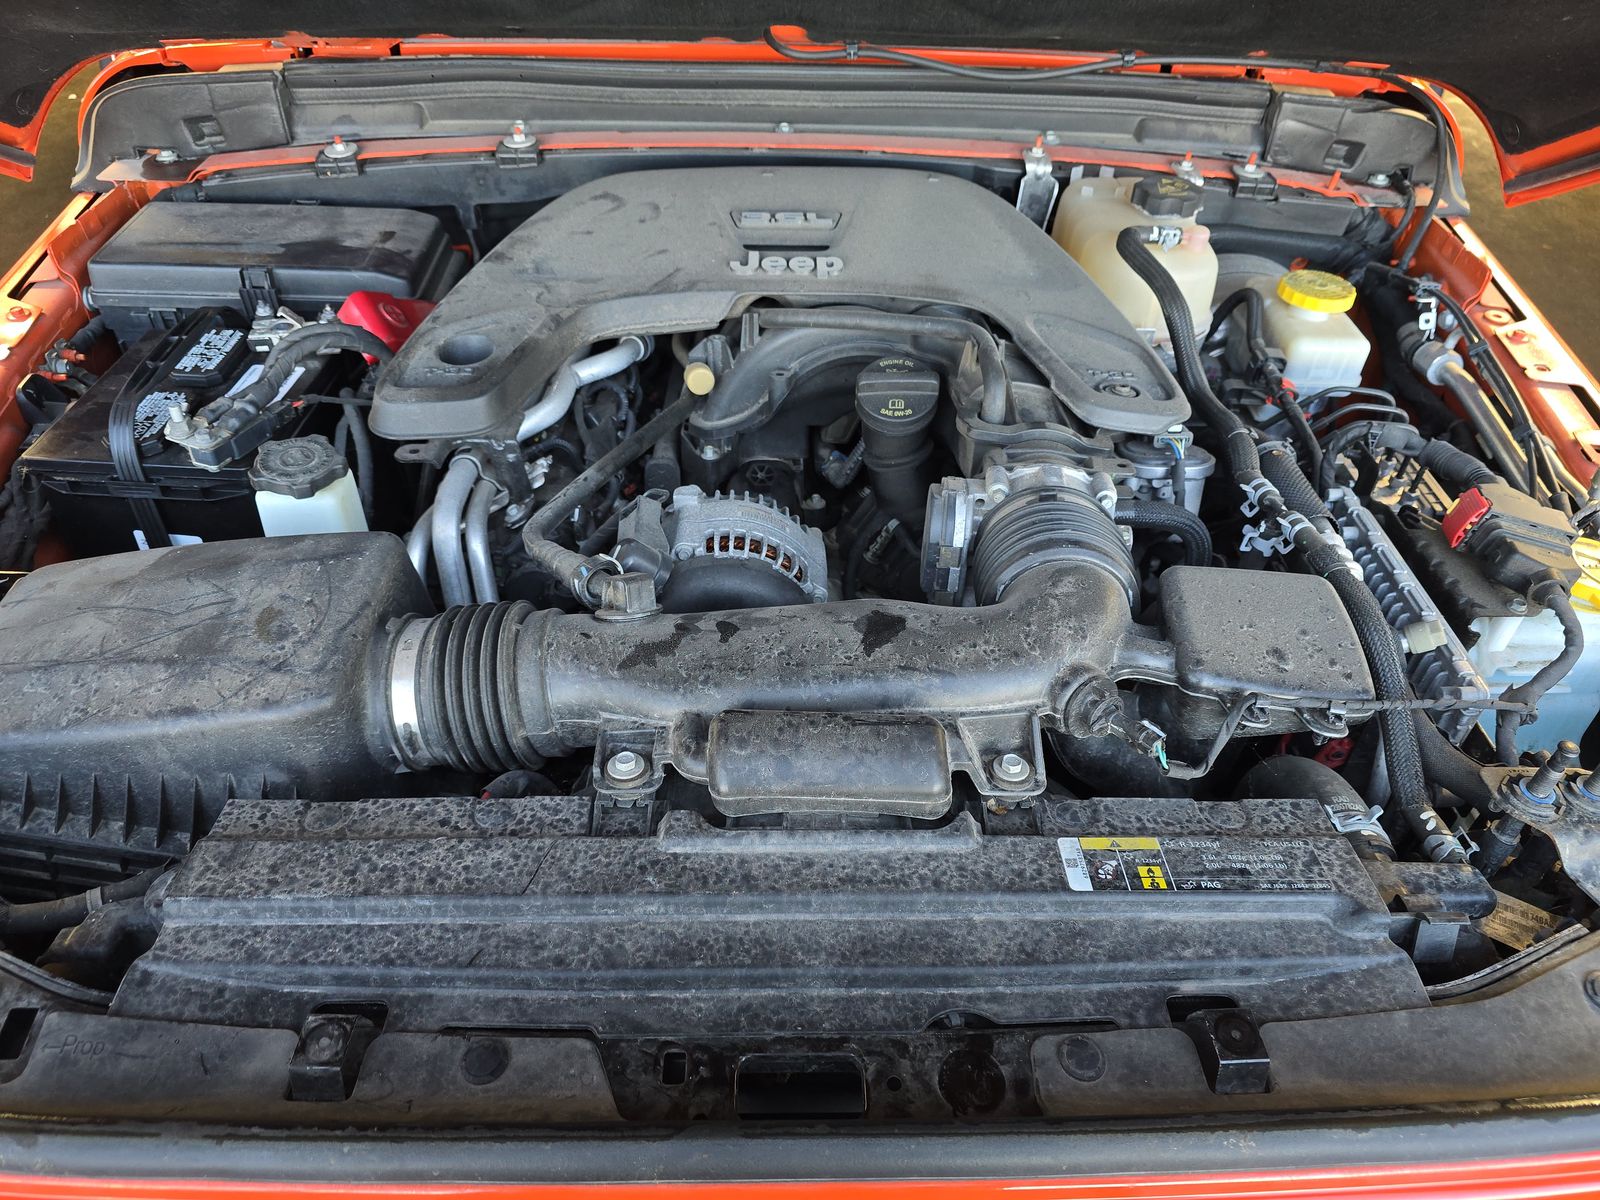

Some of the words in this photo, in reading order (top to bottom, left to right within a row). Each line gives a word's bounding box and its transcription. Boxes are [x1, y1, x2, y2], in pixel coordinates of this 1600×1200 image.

[729, 250, 844, 279] Jeep
[880, 359, 904, 367] ENGINE
[904, 360, 915, 368] OIL
[880, 408, 894, 416] SAE
[894, 408, 913, 417] 0W-20
[1331, 795, 1350, 804] RAD
[1179, 840, 1221, 850] R-1234yf
[1200, 881, 1222, 889] PAG
[59, 1034, 105, 1060] Prop
